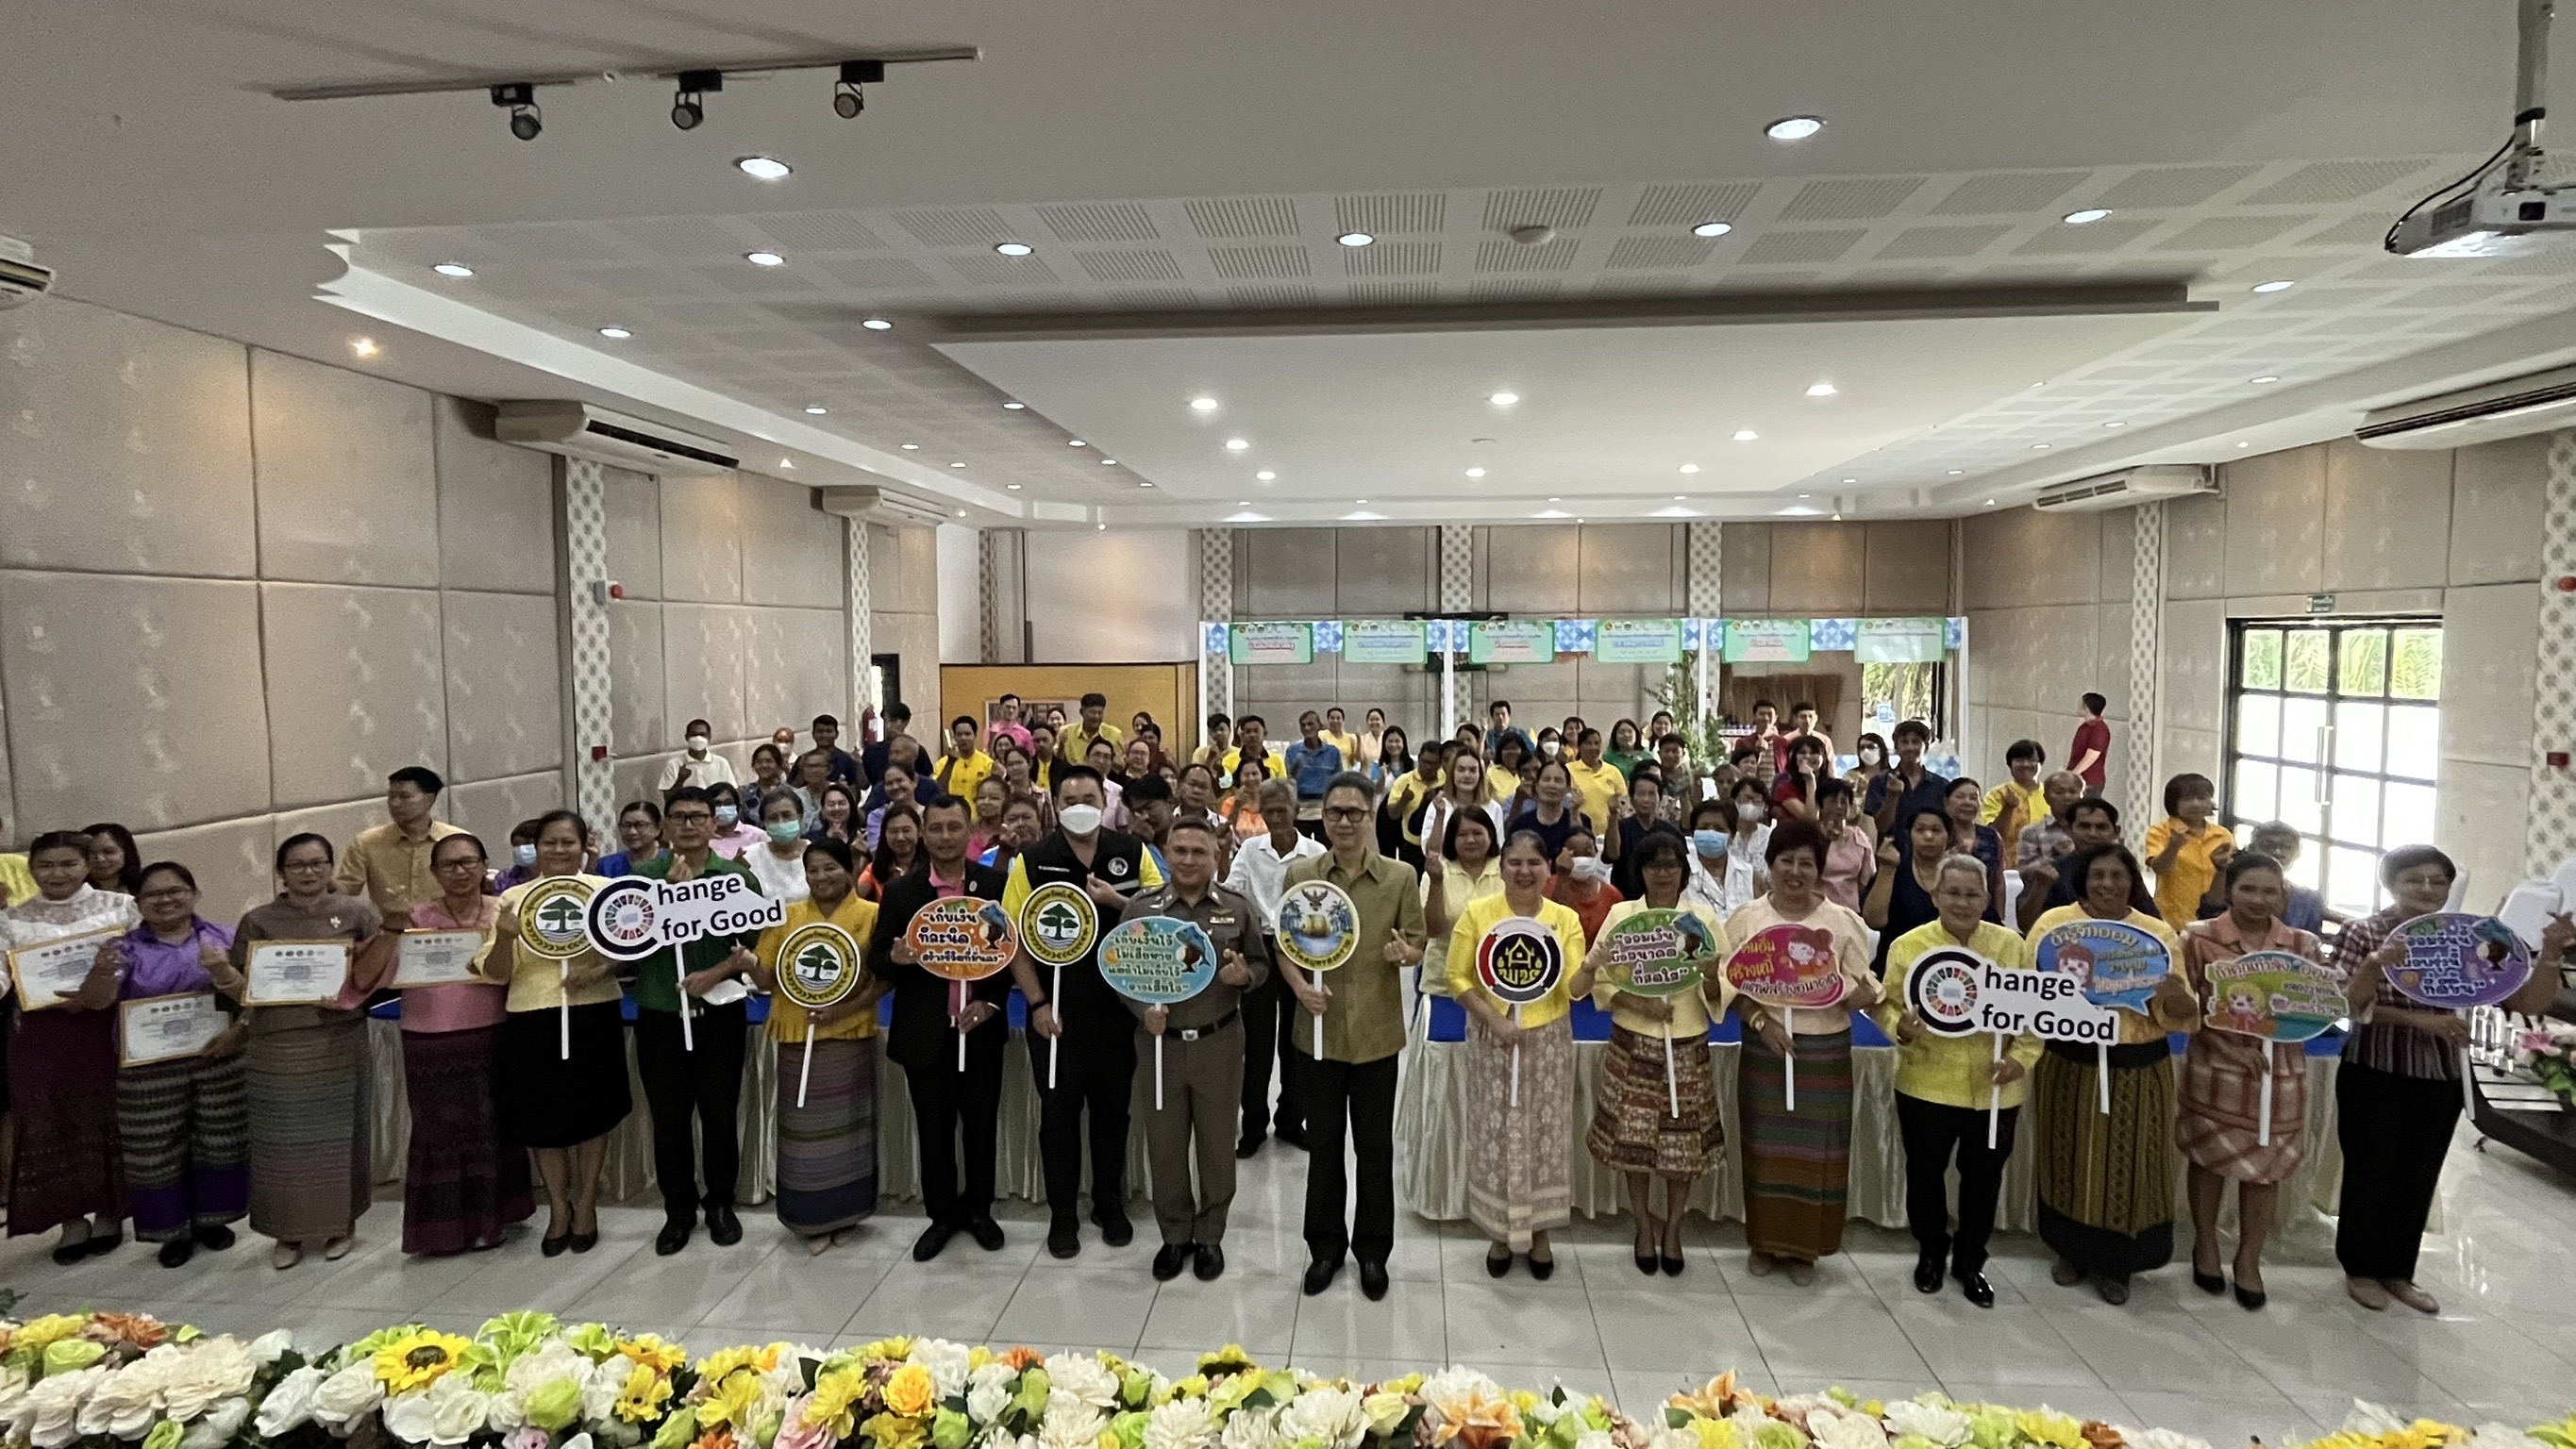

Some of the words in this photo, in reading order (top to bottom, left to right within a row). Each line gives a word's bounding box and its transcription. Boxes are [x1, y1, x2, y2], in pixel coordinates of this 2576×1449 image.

[589, 877, 741, 955] Change
[661, 917, 701, 941] for
[711, 899, 782, 931] Good
[1910, 951, 2076, 1033] Change
[1982, 1003, 2024, 1031] for
[2033, 1011, 2115, 1041] Good
